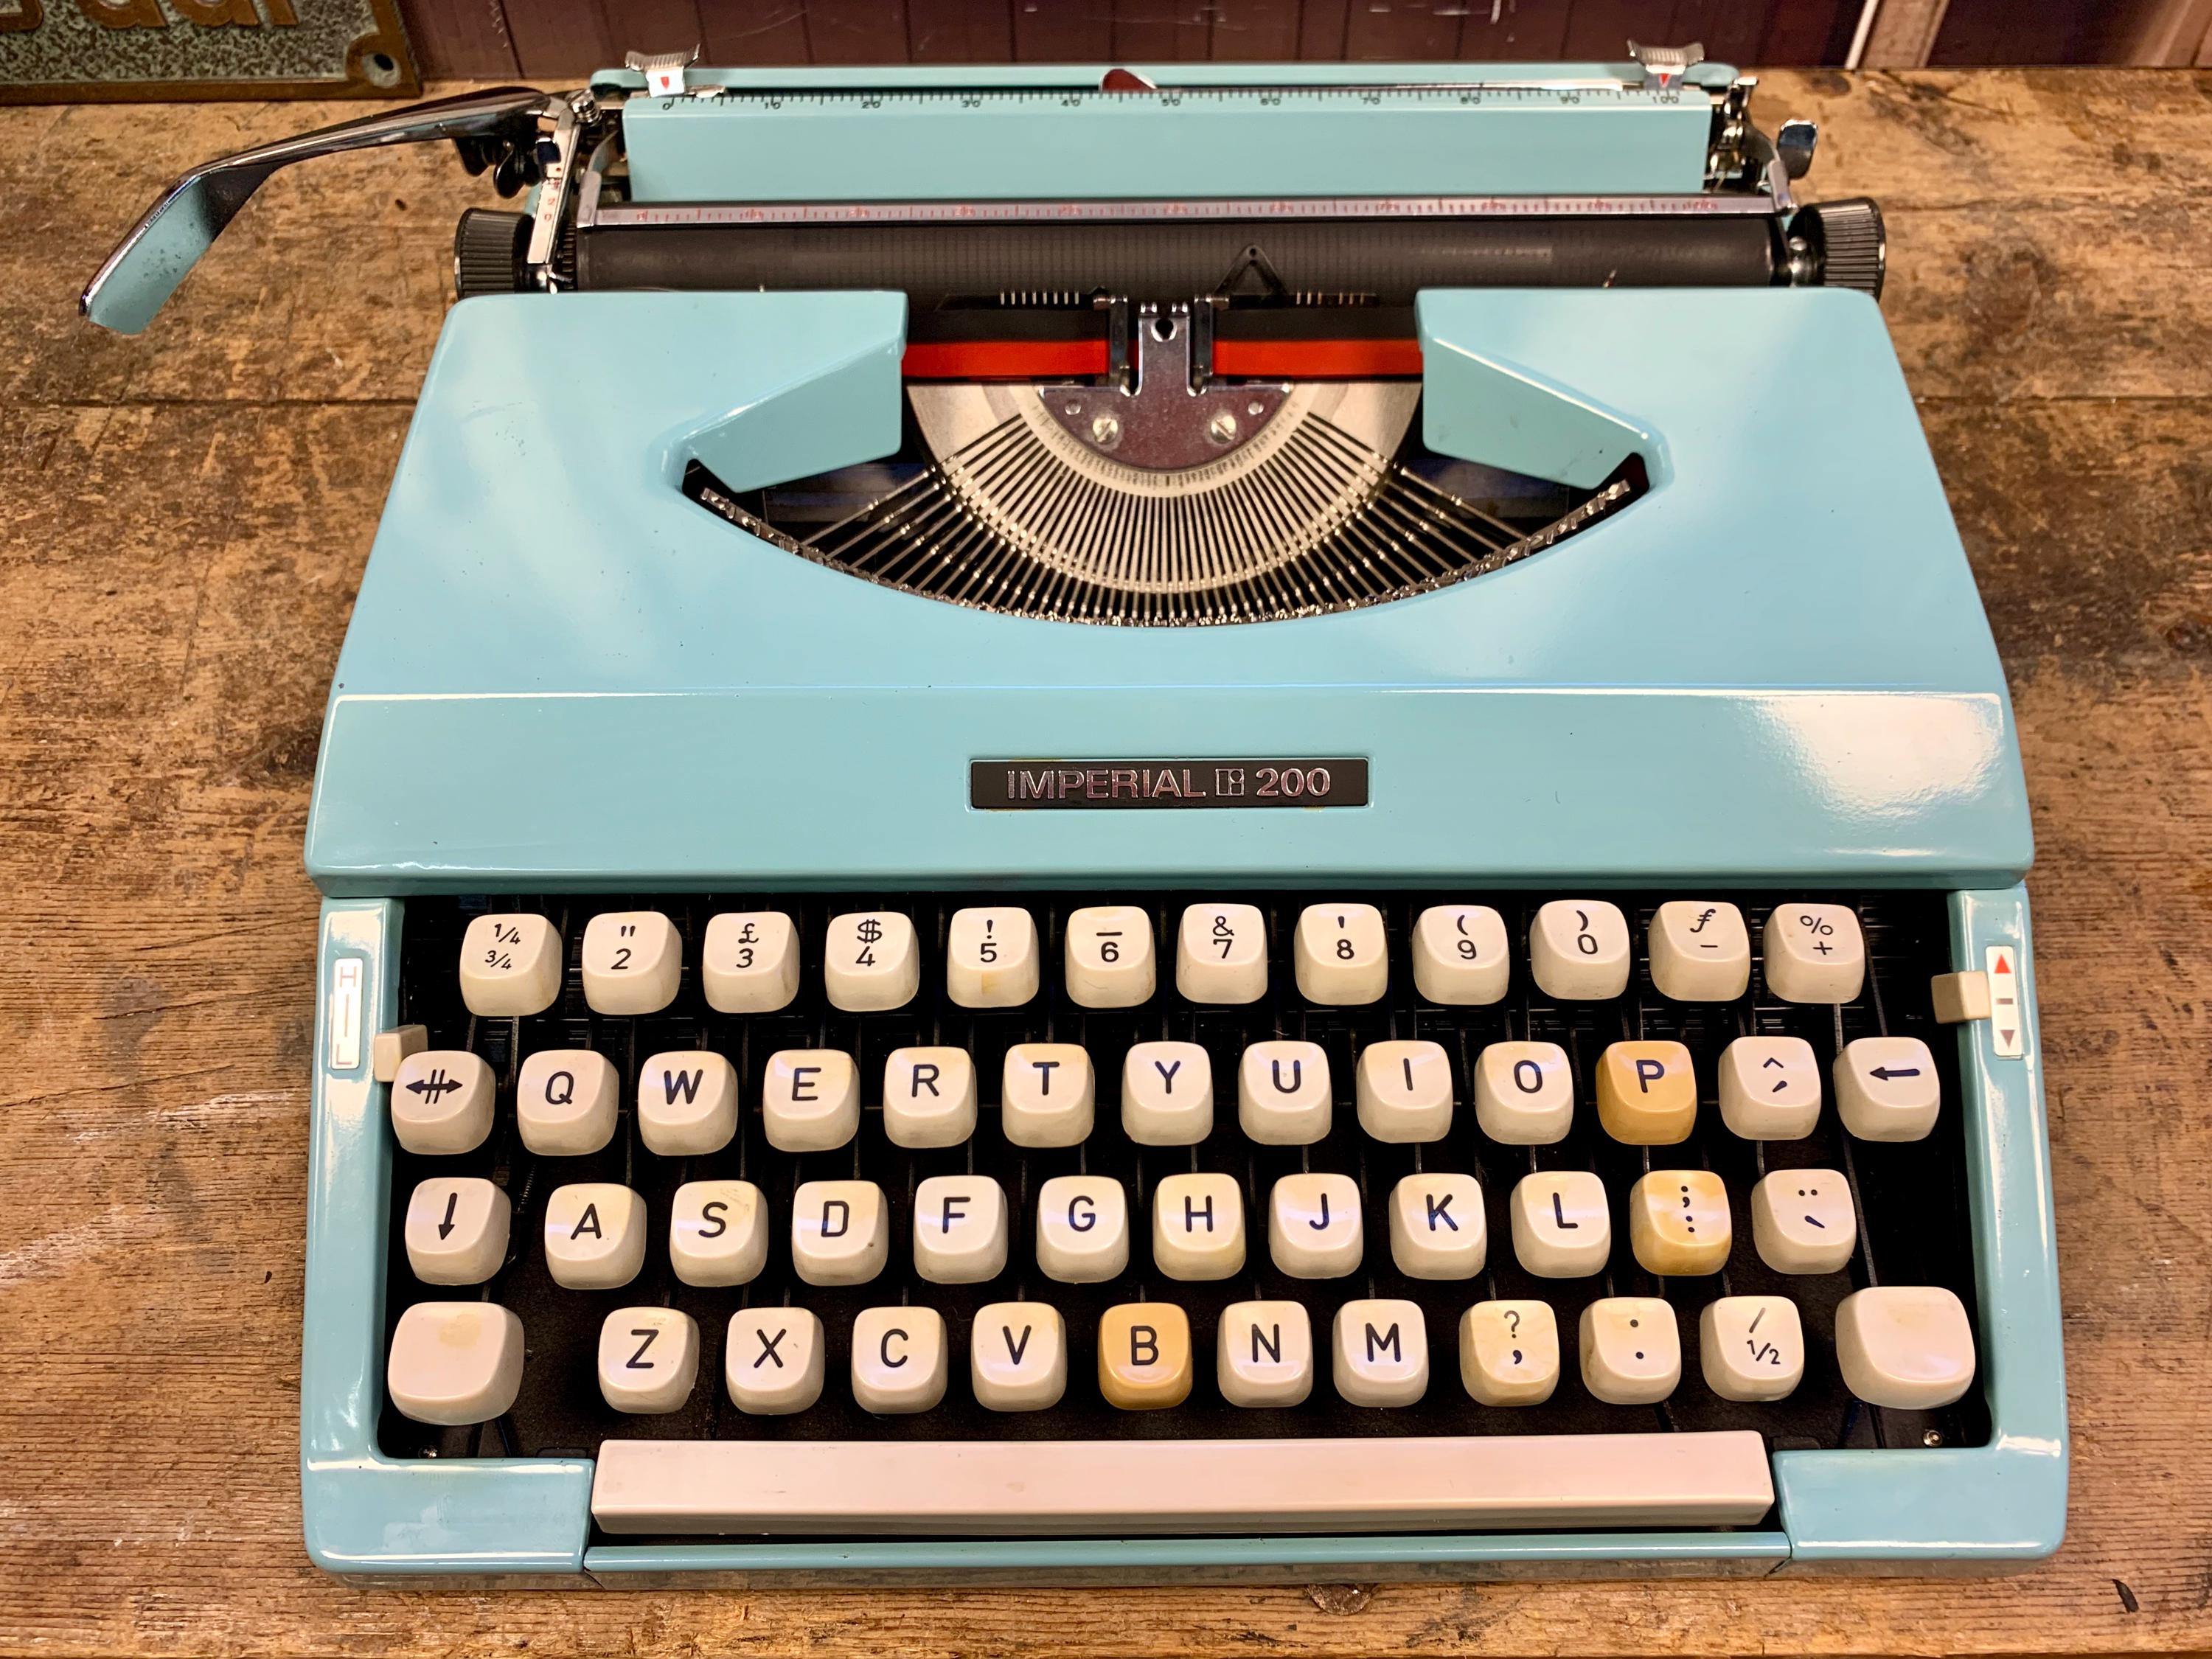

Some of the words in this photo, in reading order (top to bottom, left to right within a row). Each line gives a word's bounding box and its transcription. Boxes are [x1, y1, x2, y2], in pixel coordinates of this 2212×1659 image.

[662, 102, 671, 111] 0
[764, 102, 782, 110] 10
[861, 101, 881, 109] 20
[961, 100, 981, 108] 30
[1061, 99, 1081, 108] 40
[1161, 98, 1181, 107] 50
[1260, 97, 1281, 106] 60
[1363, 97, 1381, 105] 70
[1460, 96, 1481, 105] 80
[1560, 96, 1580, 105] 90
[1652, 95, 1679, 105] 100
[1007, 768, 1206, 799] IMPERIAL
[1255, 768, 1331, 798] 200
[737, 922, 759, 945] £
[856, 919, 883, 944] $
[986, 919, 993, 939] !
[1212, 915, 1235, 937] &
[1456, 914, 1469, 936] (
[1576, 910, 1589, 932] )
[1799, 915, 1834, 936] %
[611, 947, 632, 970] 2
[736, 947, 754, 969] 3
[855, 945, 876, 967] 4
[980, 942, 998, 963] 5
[1101, 941, 1119, 963] 6
[1213, 939, 1233, 959] 7
[1336, 939, 1355, 960] 8
[1457, 939, 1477, 960] 9
[1812, 941, 1833, 956] +
[339, 967, 358, 987] H
[335, 1043, 352, 1065] L
[545, 1071, 574, 1105] Q
[664, 1068, 703, 1105] W
[791, 1067, 822, 1102] E
[911, 1063, 940, 1098] R
[1032, 1061, 1060, 1096] T
[1154, 1060, 1181, 1095] Y
[1272, 1059, 1301, 1094] U
[1402, 1057, 1413, 1091] I
[1513, 1060, 1543, 1094] O
[1635, 1059, 1665, 1093] P
[570, 1203, 602, 1240] A
[698, 1201, 728, 1239] S
[821, 1200, 850, 1238] D
[942, 1196, 971, 1234] F
[1068, 1195, 1096, 1233] G
[1184, 1195, 1214, 1233] H
[1309, 1192, 1329, 1231] J
[1425, 1194, 1459, 1232] K
[1552, 1192, 1579, 1229] L
[1503, 1310, 1520, 1339] ?
[625, 1329, 659, 1369] Z
[753, 1328, 787, 1368] X
[880, 1328, 909, 1368] C
[1002, 1324, 1032, 1366] V
[1130, 1325, 1159, 1366] B
[1251, 1324, 1281, 1363] N
[1365, 1322, 1402, 1363] M
